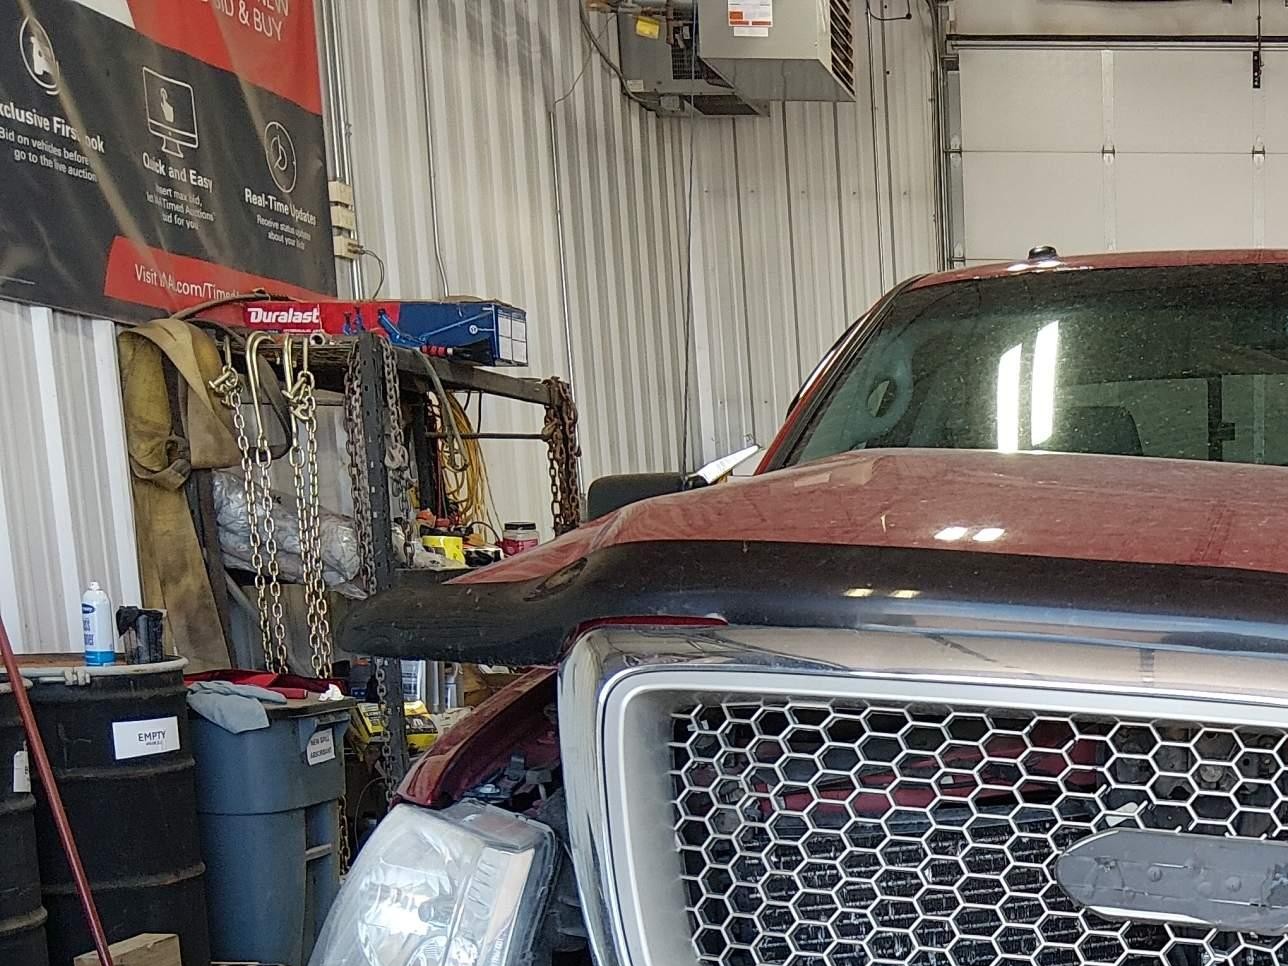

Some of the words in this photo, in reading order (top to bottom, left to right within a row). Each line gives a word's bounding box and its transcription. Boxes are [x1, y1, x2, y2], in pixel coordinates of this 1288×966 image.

[238, 0, 250, 26] &
[253, 7, 282, 41] BUY
[17, 134, 30, 146] on
[14, 149, 26, 161] go
[28, 151, 38, 164] to
[40, 154, 53, 168] the
[168, 166, 187, 182] and
[189, 168, 213, 193] Easy
[244, 187, 290, 215] Real-Time
[134, 263, 158, 287] Visit
[247, 307, 320, 323] Duralast
[137, 730, 166, 742] EMPTY
